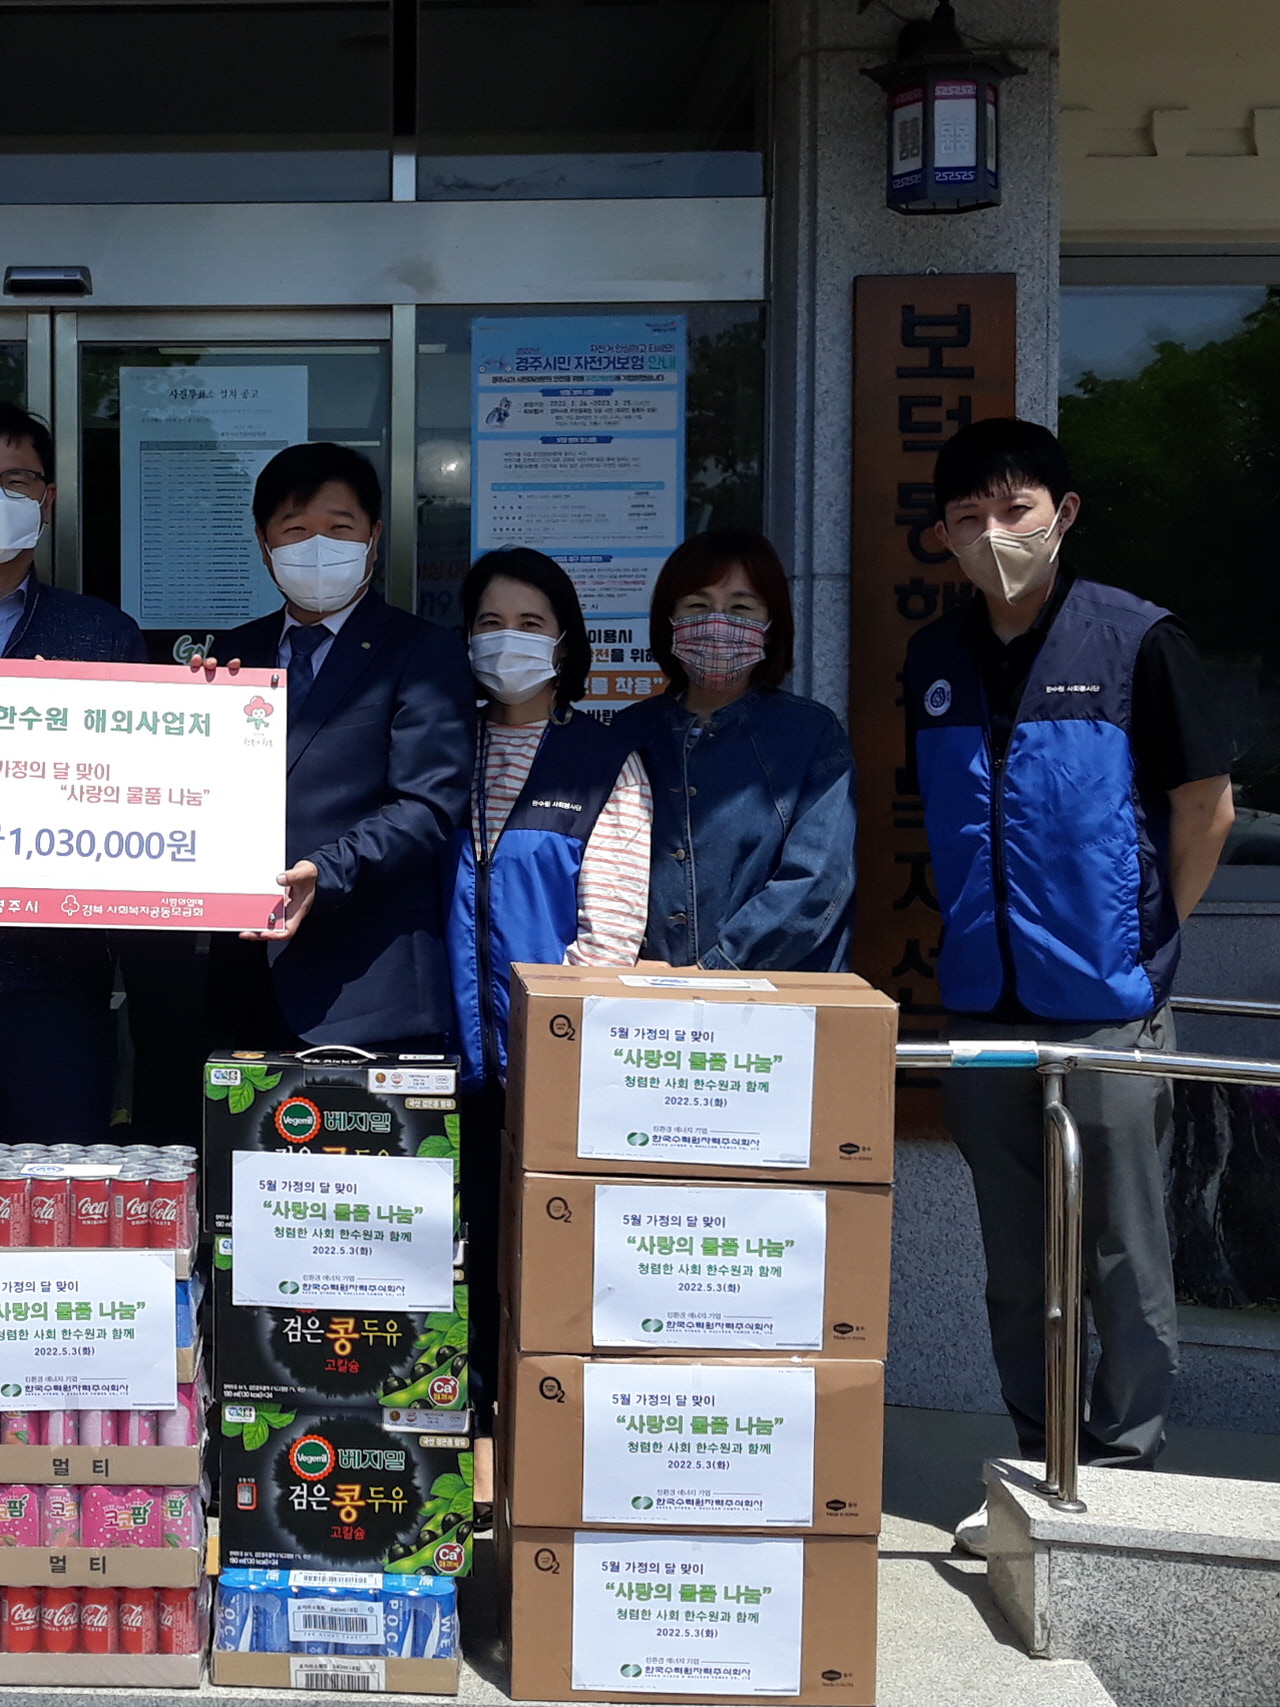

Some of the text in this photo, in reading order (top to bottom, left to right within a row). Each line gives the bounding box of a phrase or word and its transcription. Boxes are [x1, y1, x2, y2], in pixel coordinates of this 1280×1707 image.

[515, 355, 675, 371] 경주시민 자전거보험 안내
[169, 389, 258, 399] 사전투표소 설치 공고
[84, 709, 211, 737] 해외사업처
[53, 762, 69, 780] 달
[76, 763, 110, 781] 맞이
[60, 785, 210, 807] “사랑의 물품 나눔”
[82, 904, 203, 918] 경북 사회복지공동모금회
[614, 1048, 783, 1073] “사랑의 물품 나눔”
[324, 1111, 392, 1133] 베지밀
[263, 1201, 423, 1224] “사랑의 물품 나눔”
[627, 1235, 794, 1258] “사랑의 물품 나눔”
[2, 1282, 35, 1292] 가정의
[41, 1282, 51, 1292] 달
[56, 1282, 78, 1292] 맞이
[55, 1302, 92, 1321] 물품
[99, 1302, 145, 1321] 나눔”
[34, 1329, 56, 1340] 사회
[61, 1329, 107, 1340] 한수원과
[112, 1329, 134, 1340] 함께
[34, 1347, 94, 1356] 2022.5.3(화)
[325, 1359, 360, 1373] 고칼슘
[617, 1415, 783, 1435] “사랑의 물품 나눔”
[338, 1449, 406, 1470] 베지밀
[104, 1499, 154, 1530] 코코팜
[330, 1527, 366, 1539] 고칼슘
[606, 1582, 772, 1604] “사랑의 물품 나눔”
